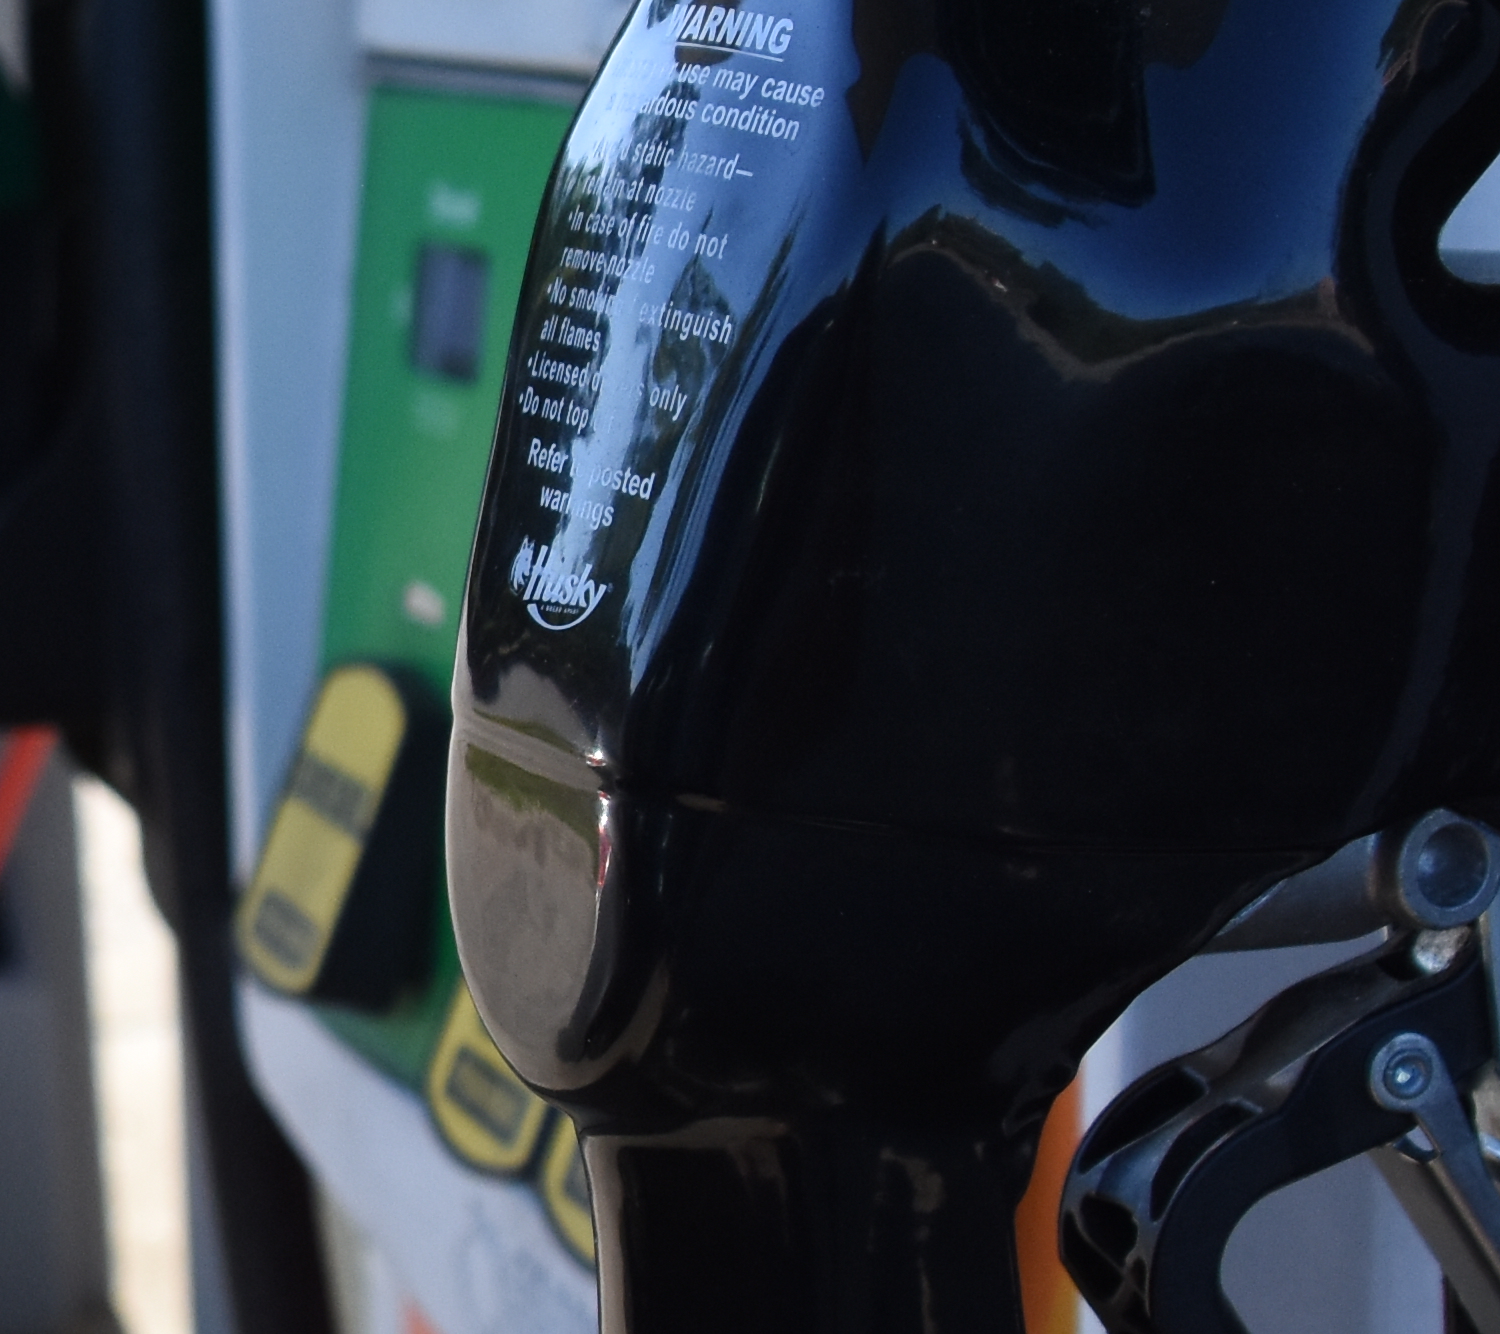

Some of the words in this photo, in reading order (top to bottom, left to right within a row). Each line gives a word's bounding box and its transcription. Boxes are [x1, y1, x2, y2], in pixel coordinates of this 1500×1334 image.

[666, 4, 794, 54] WARNING
[678, 63, 711, 85] use
[713, 69, 759, 100] may
[761, 78, 825, 108] cause
[702, 102, 800, 141] condition
[644, 183, 696, 212] nozzle
[584, 212, 615, 234] case
[618, 214, 635, 237] of
[637, 216, 664, 245] fire
[667, 222, 689, 250] do
[694, 232, 728, 260] not
[560, 246, 604, 272] remove
[607, 253, 655, 284] nozzle
[540, 316, 558, 343] all
[558, 318, 601, 352] flames
[638, 301, 733, 345] extinguish
[541, 396, 565, 422] not
[566, 399, 590, 435] top
[649, 384, 688, 423] only
[526, 437, 568, 475] Refer
[588, 464, 657, 500] posted
[523, 545, 607, 630] Husky
